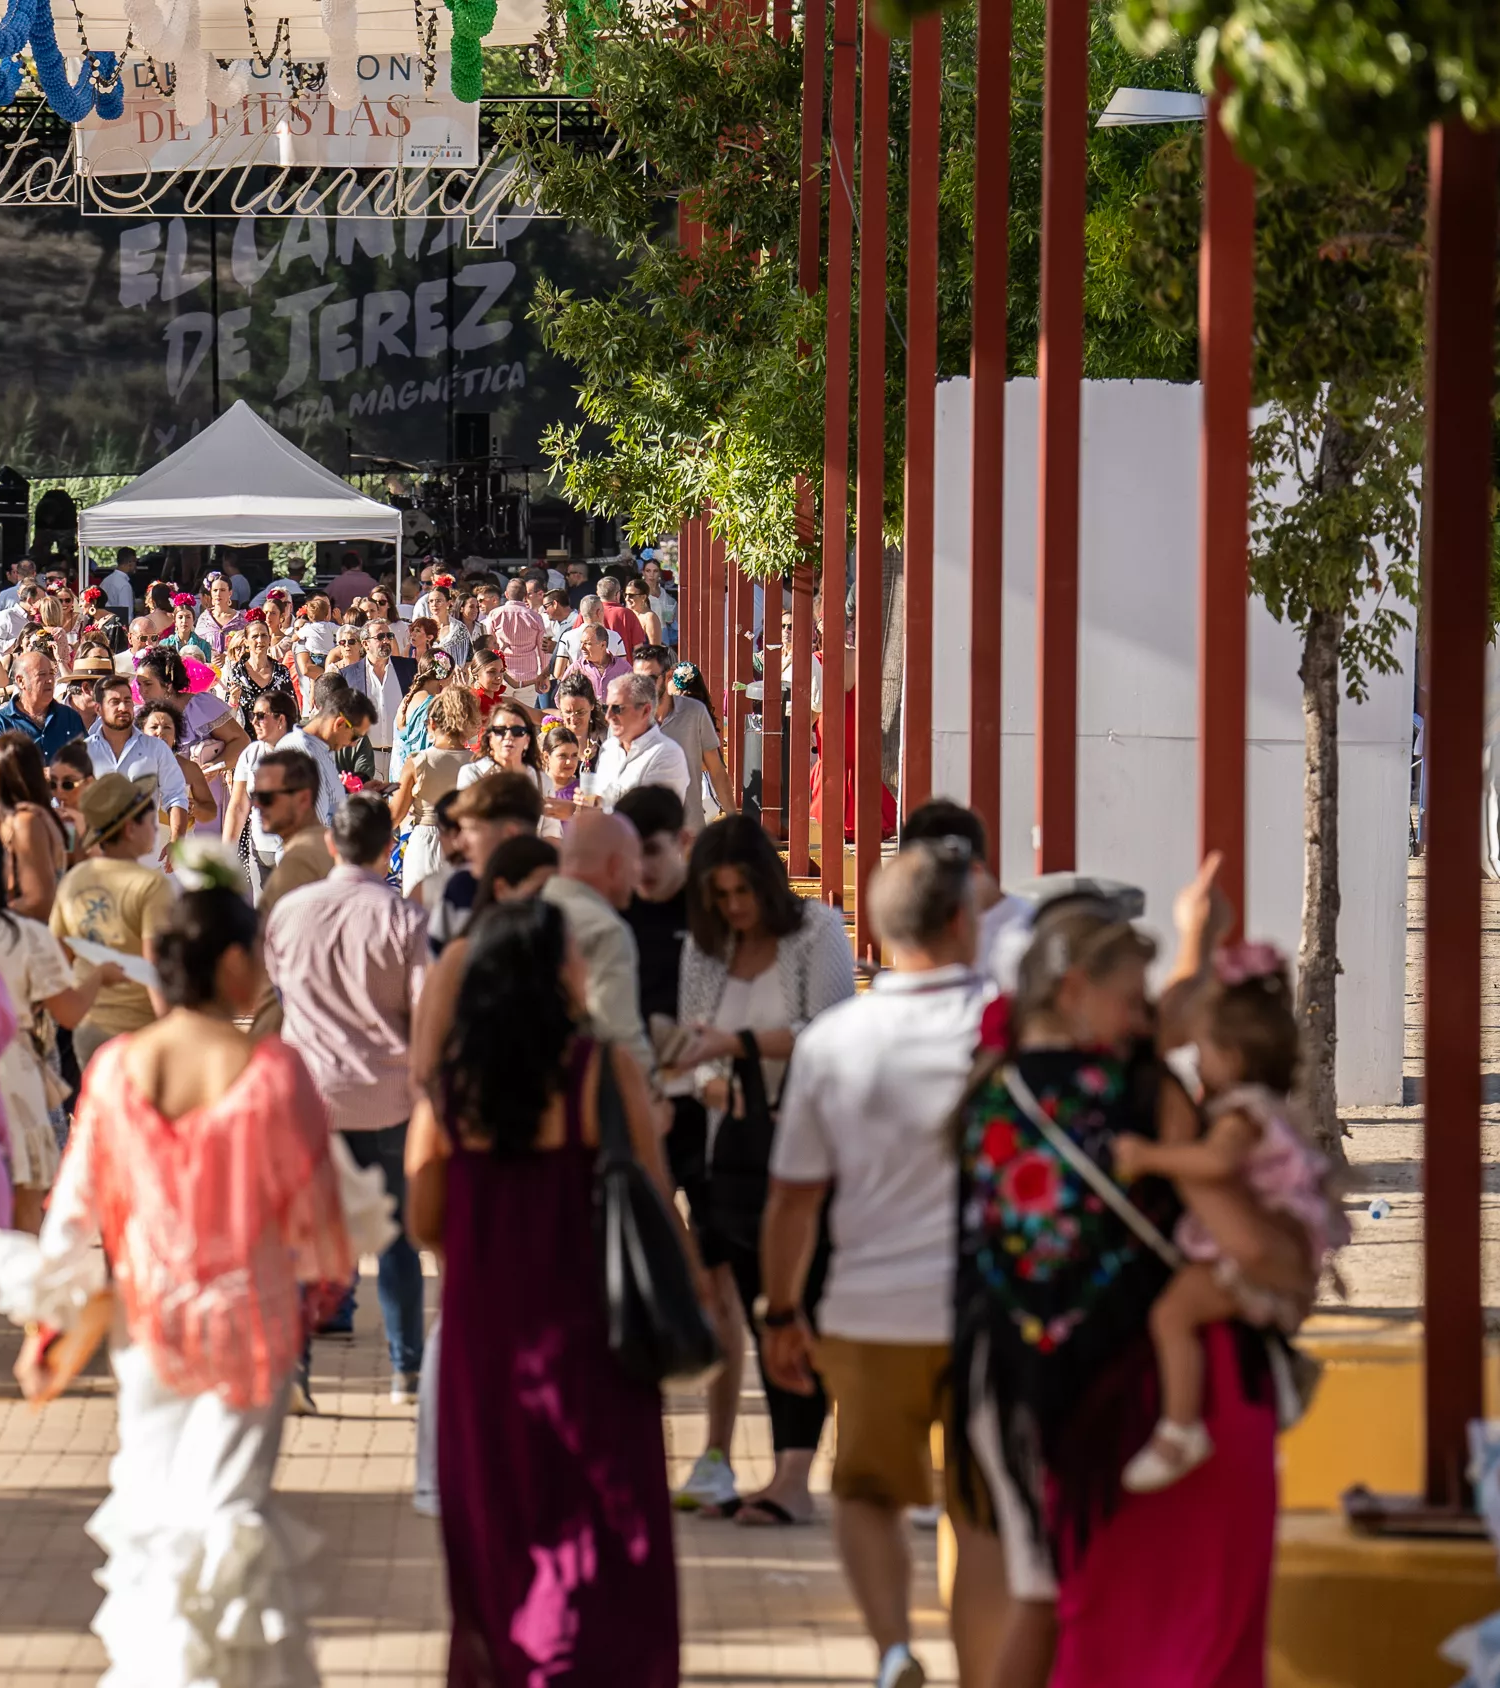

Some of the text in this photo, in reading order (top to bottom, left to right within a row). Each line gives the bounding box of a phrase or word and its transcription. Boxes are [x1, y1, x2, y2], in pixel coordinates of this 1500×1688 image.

[135, 92, 411, 143] DE FIESTAS
[119, 217, 212, 311] EL
[163, 261, 517, 405] DE JEREZ
[263, 395, 336, 429] ANDA
[348, 361, 527, 419] MAGNÉTICA
